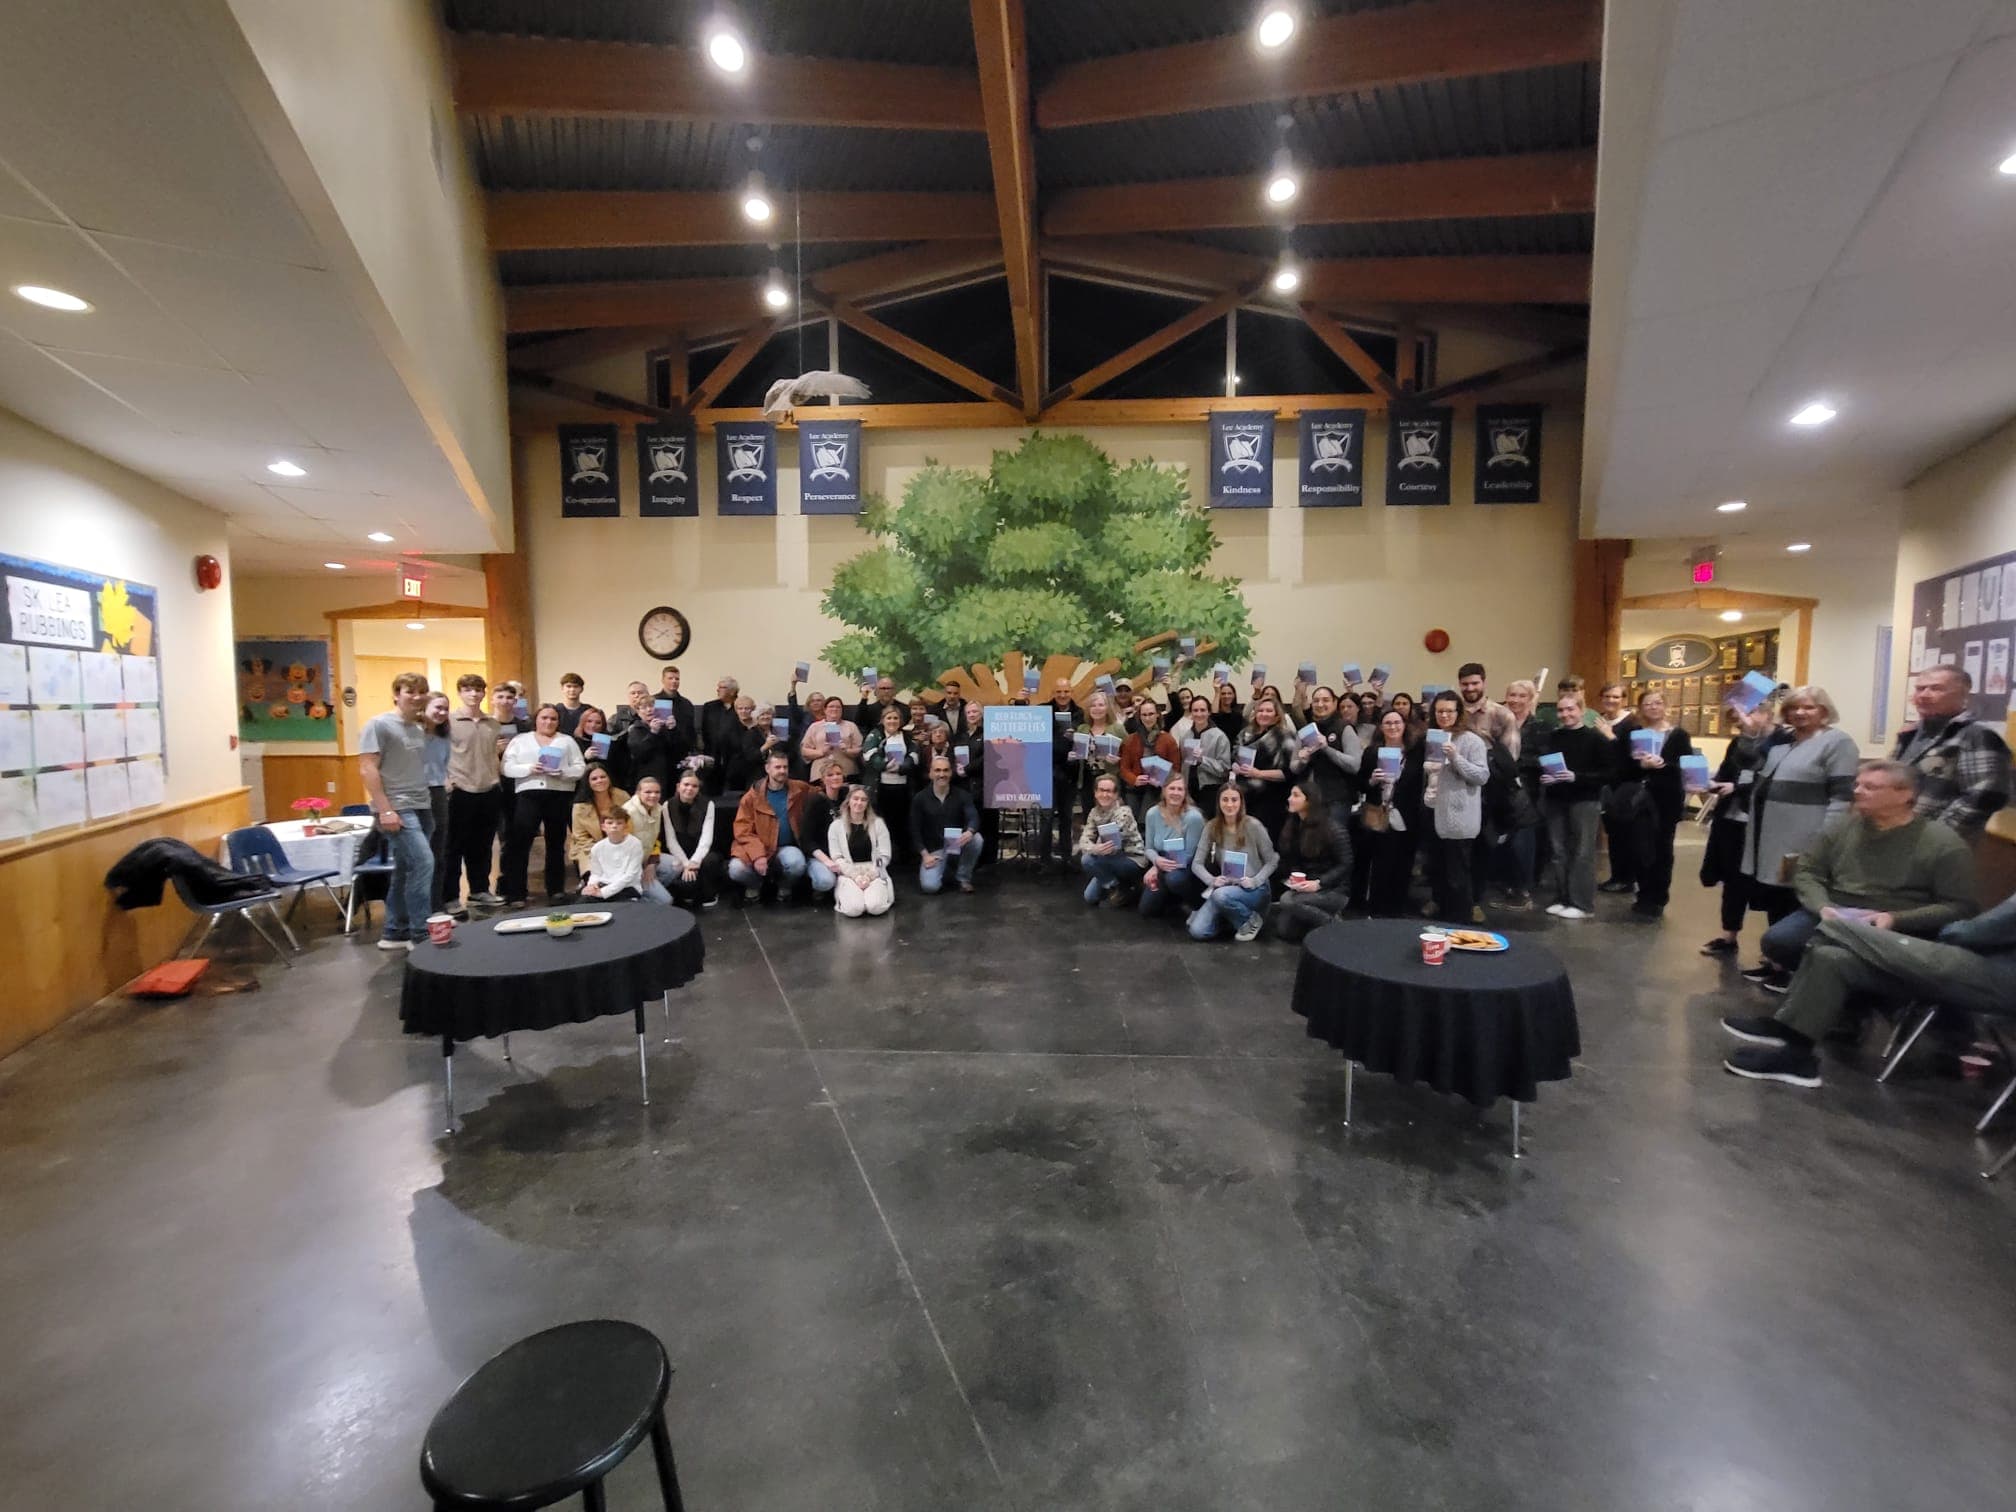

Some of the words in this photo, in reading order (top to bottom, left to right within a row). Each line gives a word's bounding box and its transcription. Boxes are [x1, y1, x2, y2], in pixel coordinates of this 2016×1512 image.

[1222, 485, 1262, 495] Kindness
[1301, 483, 1361, 495] Responsibility
[651, 495, 686, 505] Integrity
[731, 493, 763, 504] Respect
[804, 492, 857, 501] Perseverance
